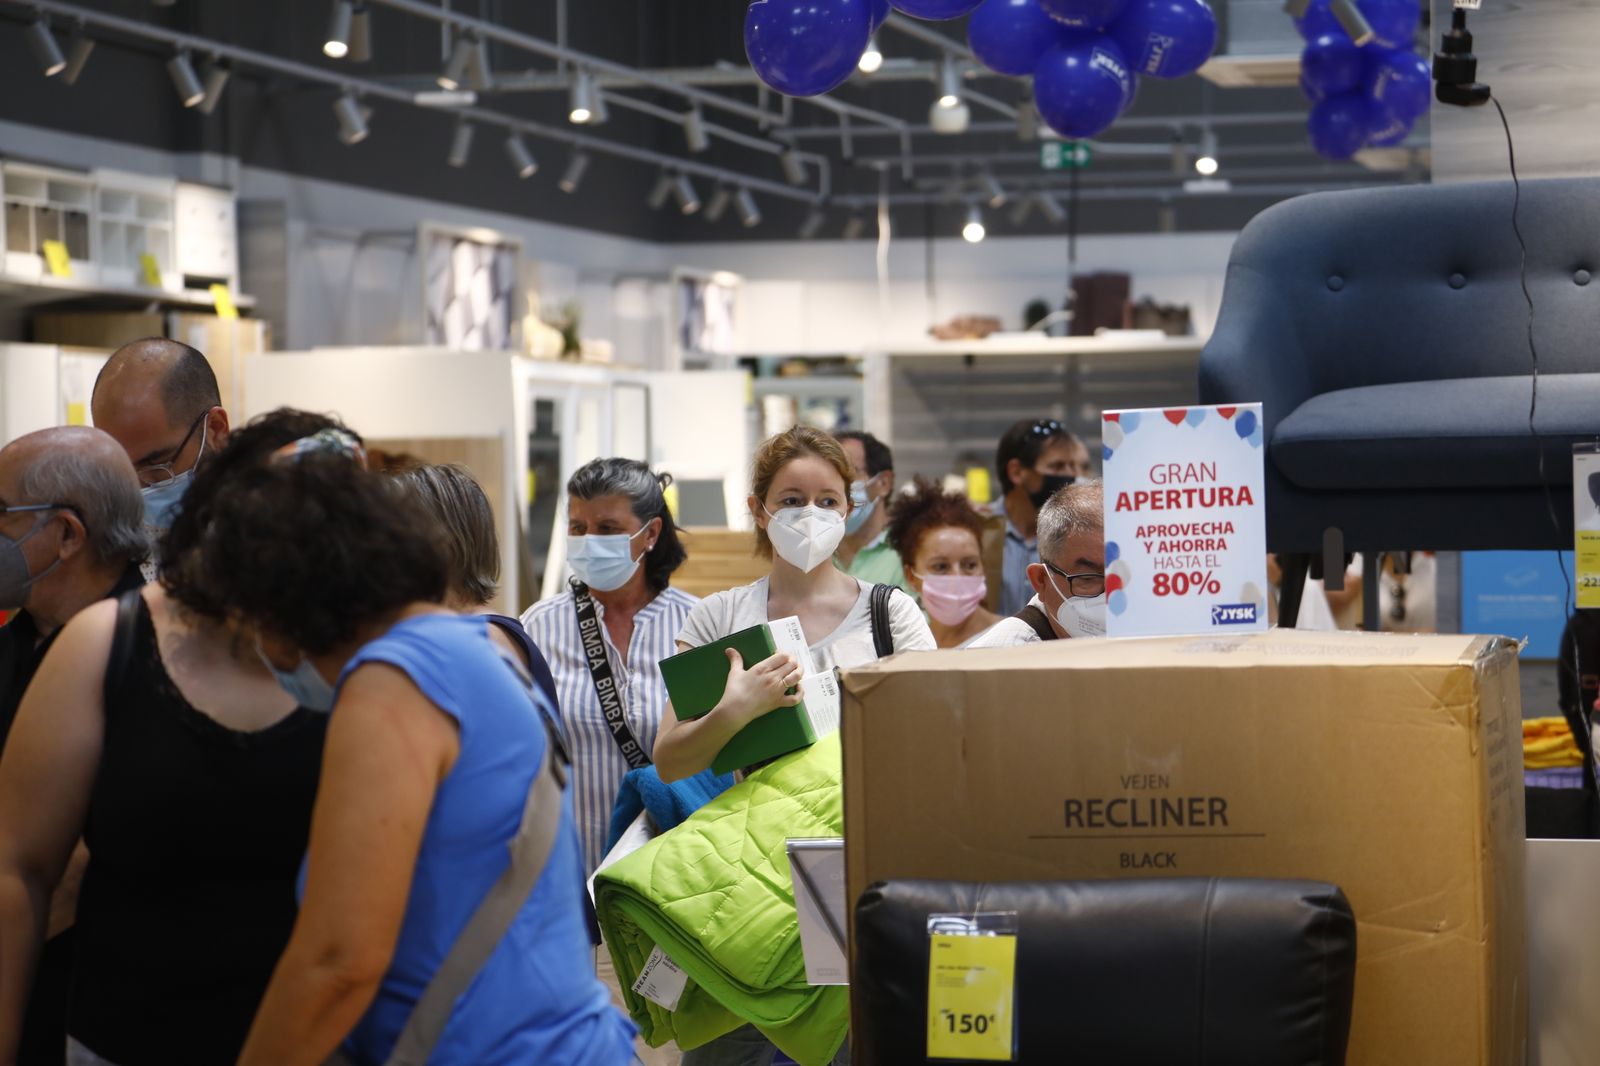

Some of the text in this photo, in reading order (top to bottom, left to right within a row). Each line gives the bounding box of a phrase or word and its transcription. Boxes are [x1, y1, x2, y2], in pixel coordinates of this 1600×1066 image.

[1149, 461, 1217, 485] GRAN
[1115, 485, 1254, 512] APERTURA
[1135, 521, 1235, 538] APROVECHA
[1144, 537, 1227, 554] Y AHORRA
[1153, 554, 1222, 570] HASTA EL
[1152, 570, 1221, 597] 80%
[1220, 606, 1255, 620] JYSK
[580, 617, 606, 671] BIMBA
[596, 677, 624, 735] BIMBA
[1121, 774, 1169, 791] VEJEN
[1064, 796, 1229, 829] RECLINER
[1120, 852, 1177, 869] BLACK
